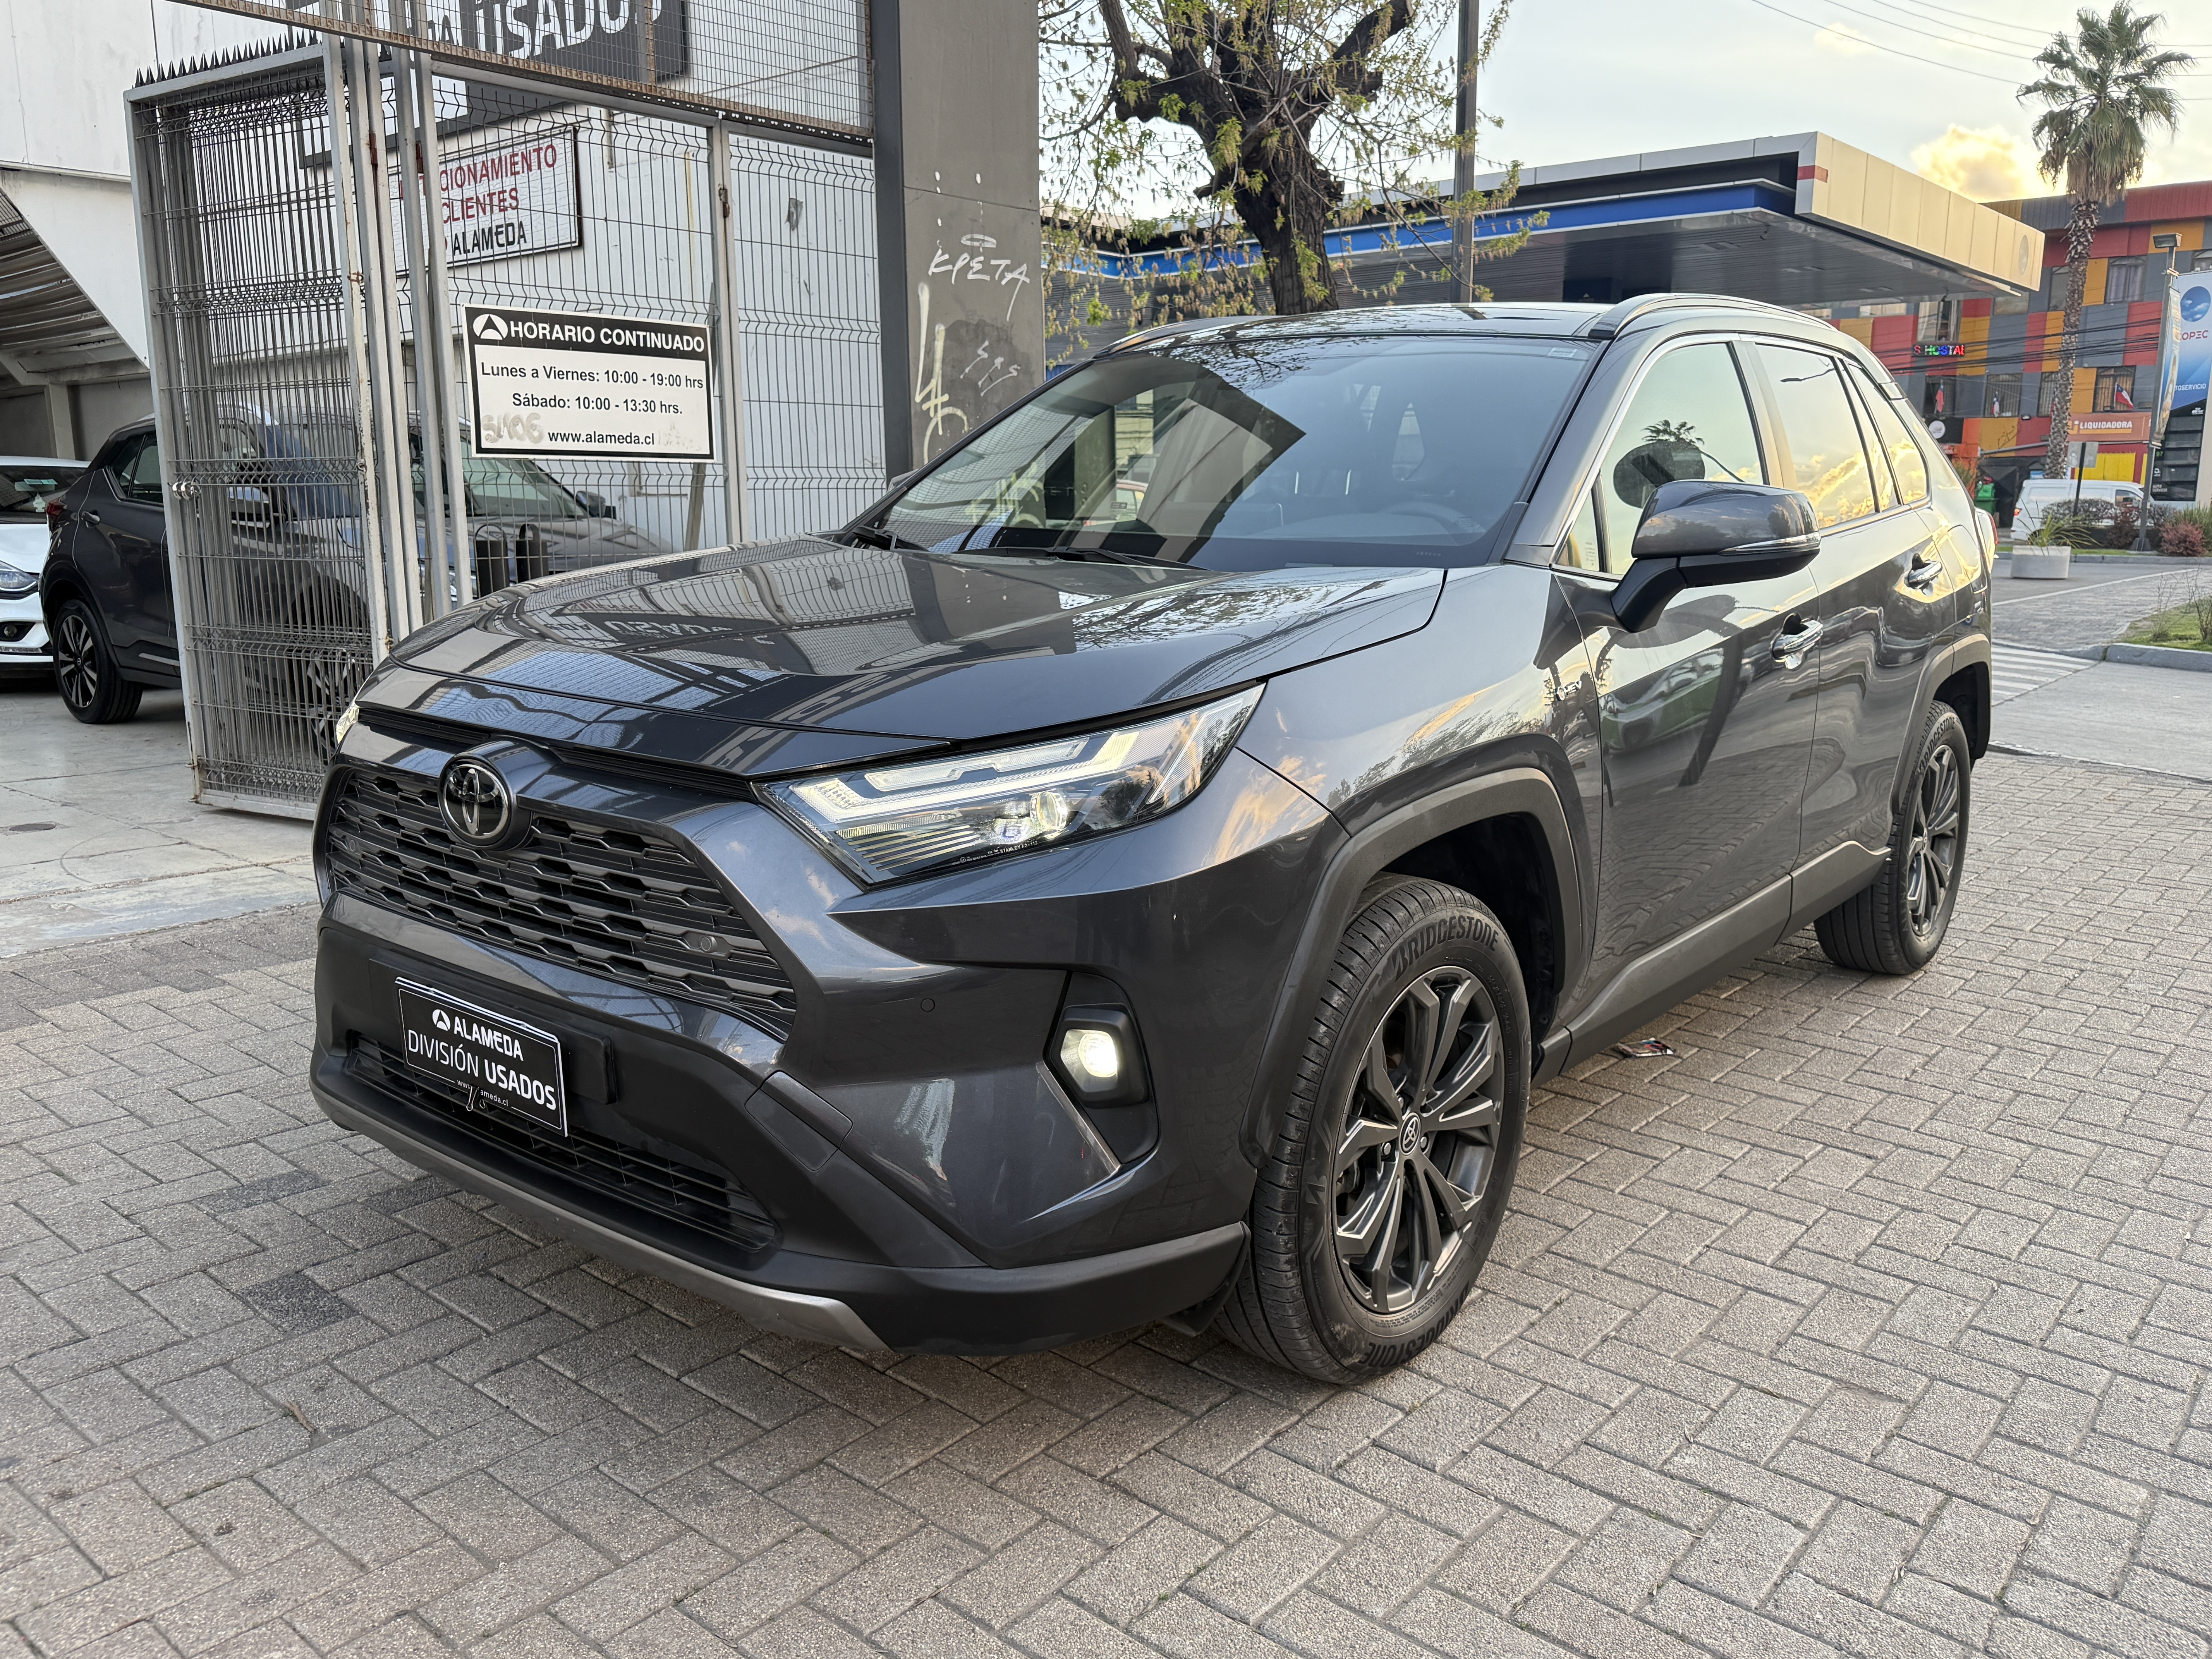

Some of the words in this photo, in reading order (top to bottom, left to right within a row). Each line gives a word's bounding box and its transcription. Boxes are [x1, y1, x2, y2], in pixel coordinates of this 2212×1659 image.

[453, 221, 527, 256] ALAMEDA
[510, 321, 595, 343] HORARIO
[600, 328, 704, 352] CONTINUADO
[2181, 330, 2209, 340] OPEC
[481, 362, 527, 378] Lunes
[531, 368, 539, 378] a
[543, 365, 599, 382] Viernes:
[604, 369, 638, 384] 10:00
[650, 373, 682, 387] 19:00
[685, 375, 703, 388] hrs
[512, 392, 570, 409] Sábado:
[575, 396, 610, 410] 10:00
[623, 398, 656, 413] 13:30
[660, 400, 683, 414] hrs.
[548, 429, 654, 445] www.alameda.cl
[1000, 845, 1020, 854] STANLEY
[1393, 915, 1499, 983] BRIDGESTONE
[454, 1016, 524, 1061] ALAMEDA
[408, 1029, 478, 1077] DIVISIÓN
[484, 1059, 556, 1111] USADOS
